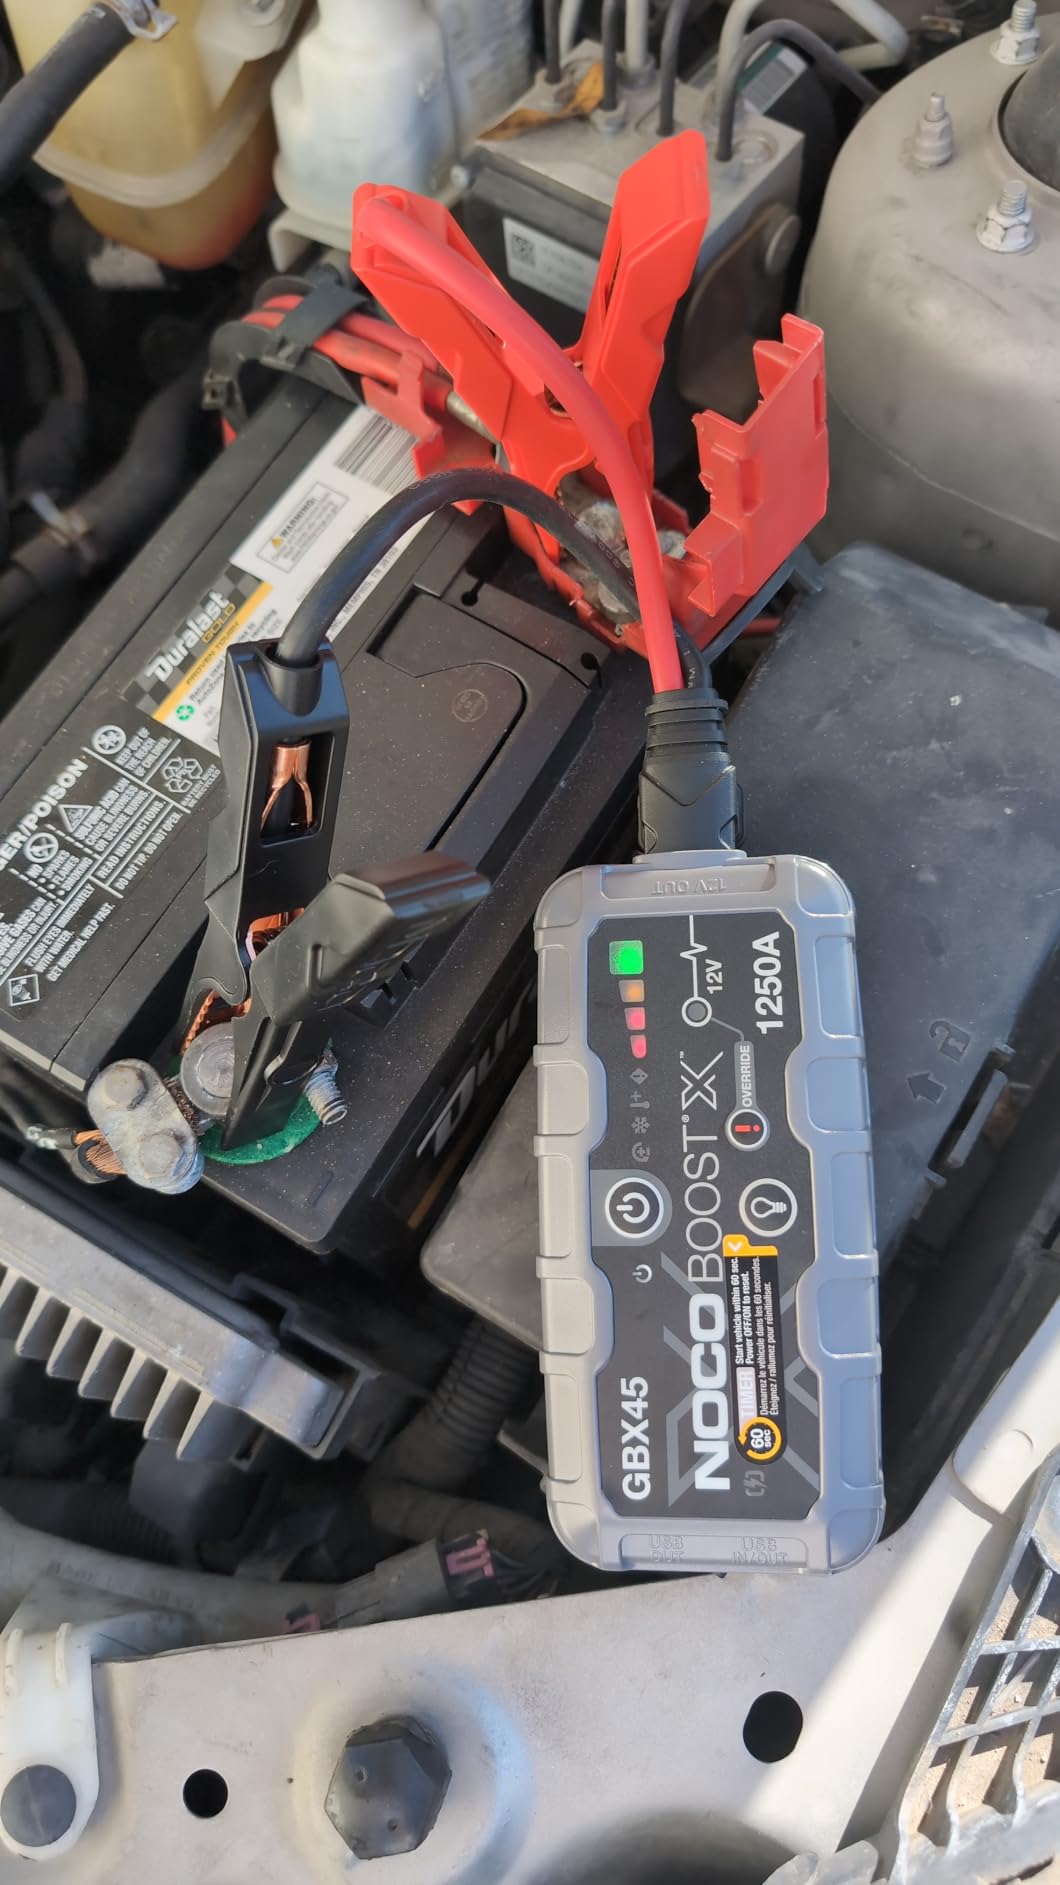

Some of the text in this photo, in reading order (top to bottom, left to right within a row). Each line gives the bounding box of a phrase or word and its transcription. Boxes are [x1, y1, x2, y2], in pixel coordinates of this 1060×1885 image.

[143, 591, 230, 682] Duralast
[200, 601, 237, 643] GOLD
[185, 650, 216, 685] PROVEN
[214, 619, 240, 649] TOUGH
[188, 675, 211, 701] Return
[115, 726, 150, 765] KEEP OUT OF
[124, 738, 156, 771] THE REACH
[134, 737, 172, 776] OF CHILDREN.
[99, 789, 120, 808] ACID
[113, 776, 130, 792] CAN
[84, 783, 138, 845] CAUSE BLINDNESS
[94, 789, 150, 852] OR SEVERE BURNS.
[96, 799, 166, 878] READ INSTRUCTIONS.
[114, 877, 128, 890] DO
[122, 863, 139, 881] NOT
[143, 841, 157, 854] DO
[151, 828, 168, 845] NOT
[161, 812, 183, 831] OPEN.
[24, 862, 43, 879] NO
[41, 848, 70, 879] SPARKS
[50, 854, 80, 885] FLAMES
[60, 855, 93, 892] SMOKING
[654, 880, 689, 896] OUT
[0, 900, 58, 966] BLINDNESS OR INJURY.
[8, 908, 36, 938] GASES
[30, 896, 47, 912] CAN
[23, 882, 94, 966] FLUSH EYES IMMEDIATELY
[33, 929, 74, 973] WITH WATER.
[46, 902, 115, 982] GET MEDICAL HELP FAST.
[705, 958, 722, 993] 12V
[752, 931, 783, 1034] 1250A
[739, 1044, 752, 1106] OVERRIDE
[730, 1274, 739, 1285] 60
[751, 1256, 760, 1292] secondes.
[730, 1287, 740, 1311] within
[753, 1294, 761, 1303] 60
[763, 1282, 773, 1324] réinitialiser.
[733, 1313, 742, 1342] vehicle
[741, 1271, 753, 1364] Power OFF/ON to reset.
[755, 1318, 764, 1335] dans
[766, 1326, 776, 1342] pour
[734, 1344, 744, 1363] Start
[756, 1338, 765, 1368] véhicule
[767, 1345, 776, 1376] rallumez
[689, 1294, 731, 1491] NOCO
[740, 1369, 753, 1418] TIMER
[759, 1380, 768, 1414] Démarrez
[769, 1383, 778, 1415] Éteignez
[620, 1376, 650, 1499] GBX45
[750, 1428, 764, 1449] 60
[762, 1428, 772, 1449] sec
[648, 1535, 683, 1550] USB
[743, 1537, 777, 1552] USB
